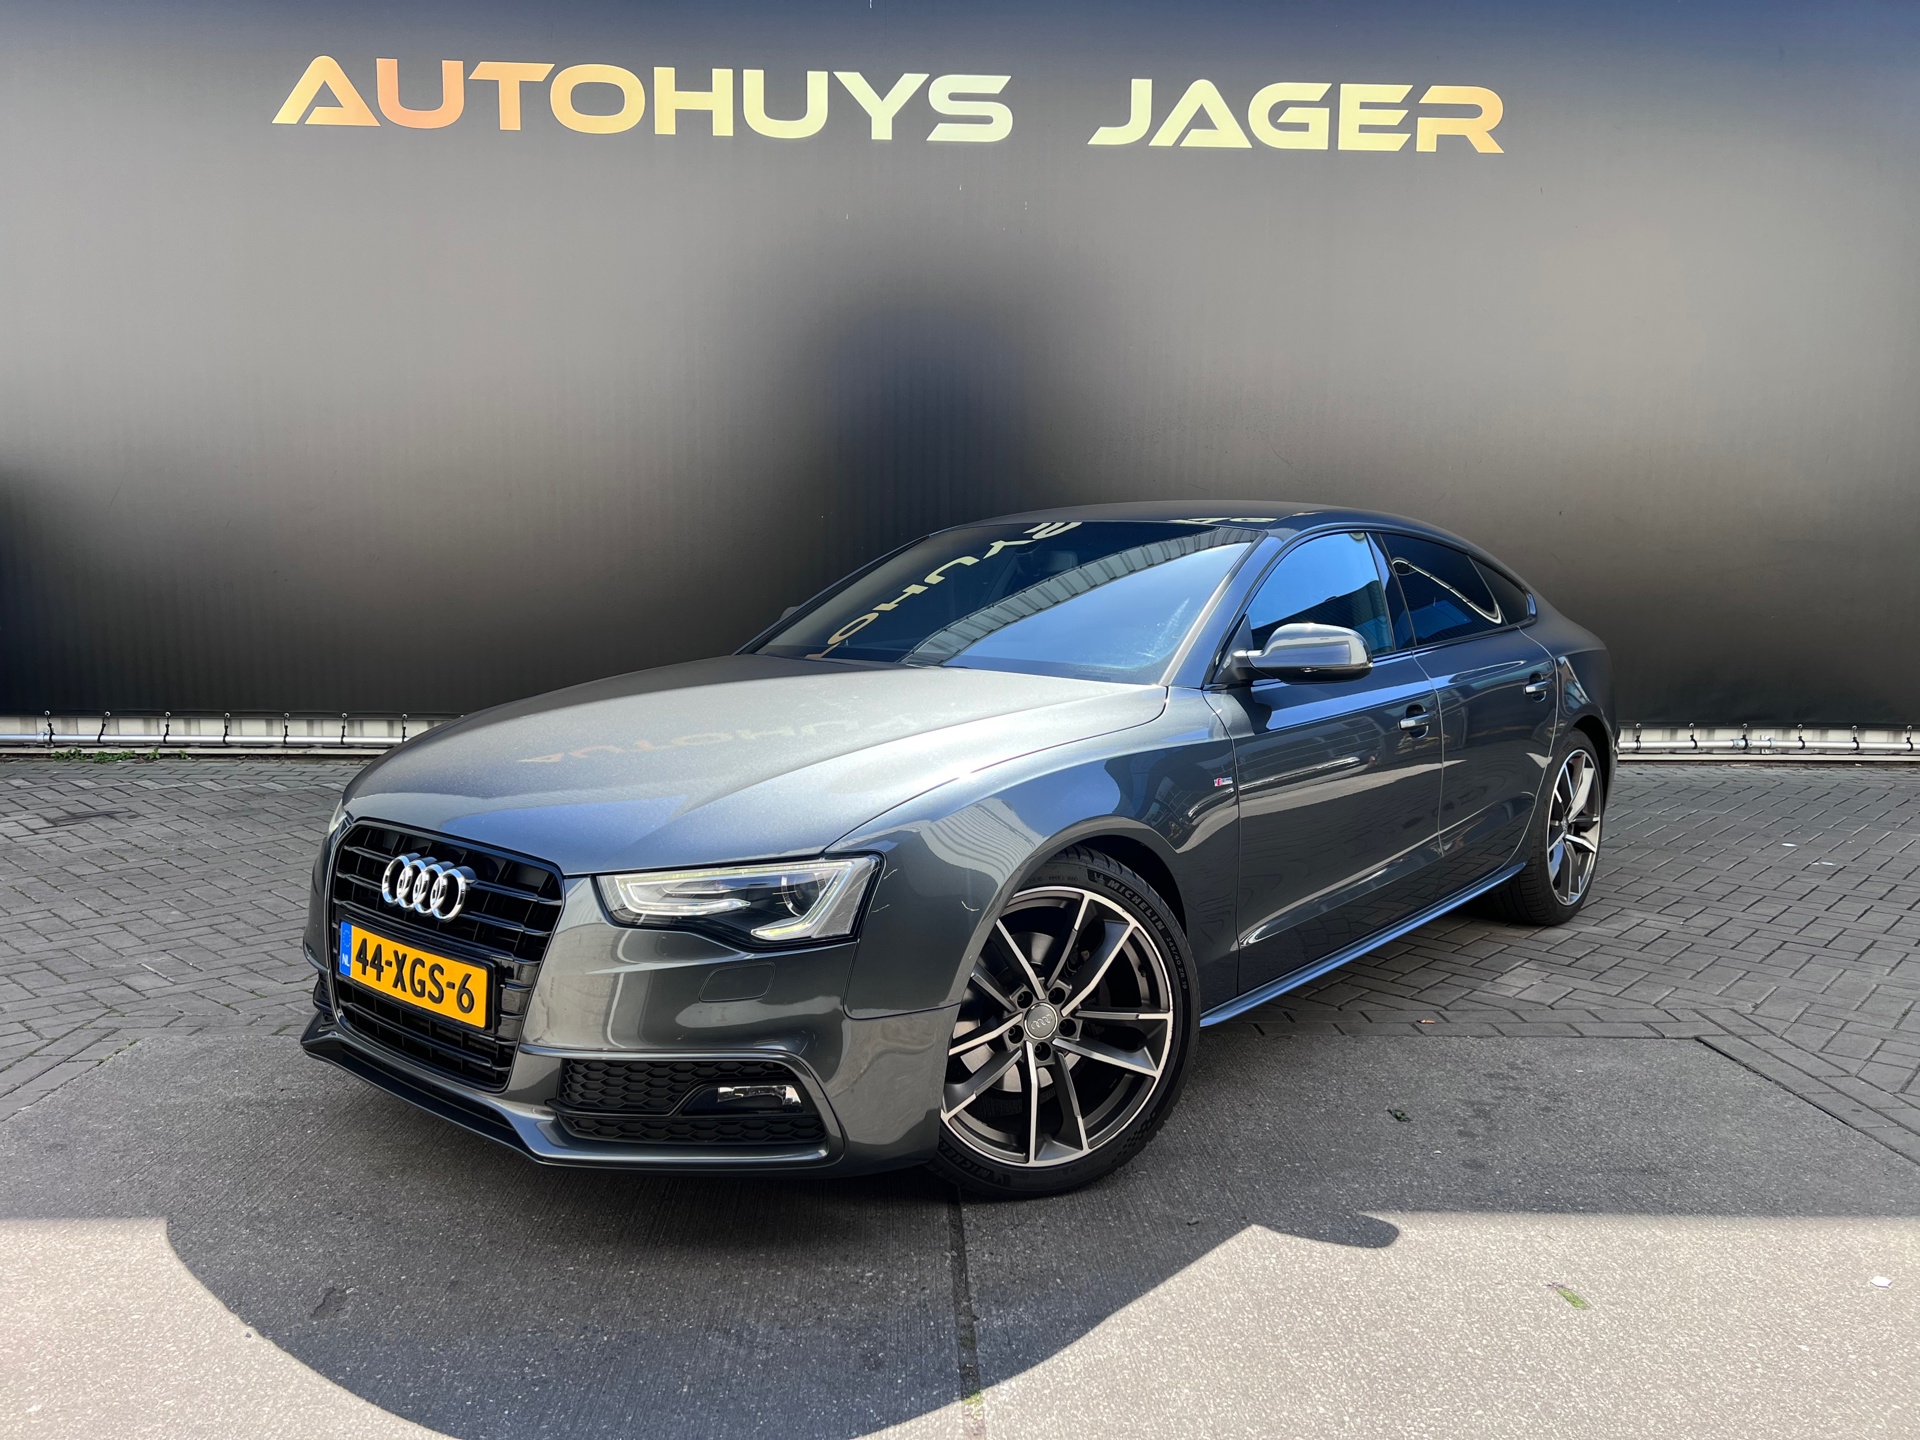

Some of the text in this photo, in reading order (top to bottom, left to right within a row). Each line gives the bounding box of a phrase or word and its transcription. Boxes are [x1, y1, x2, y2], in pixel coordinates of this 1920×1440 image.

[272, 55, 1504, 153] AUTOHUYS JAGER
[1107, 880, 1165, 931] MICHELIN
[341, 952, 350, 967] NL
[355, 938, 475, 1014] 44-XGS-6
[938, 1139, 992, 1179] MICHEL
